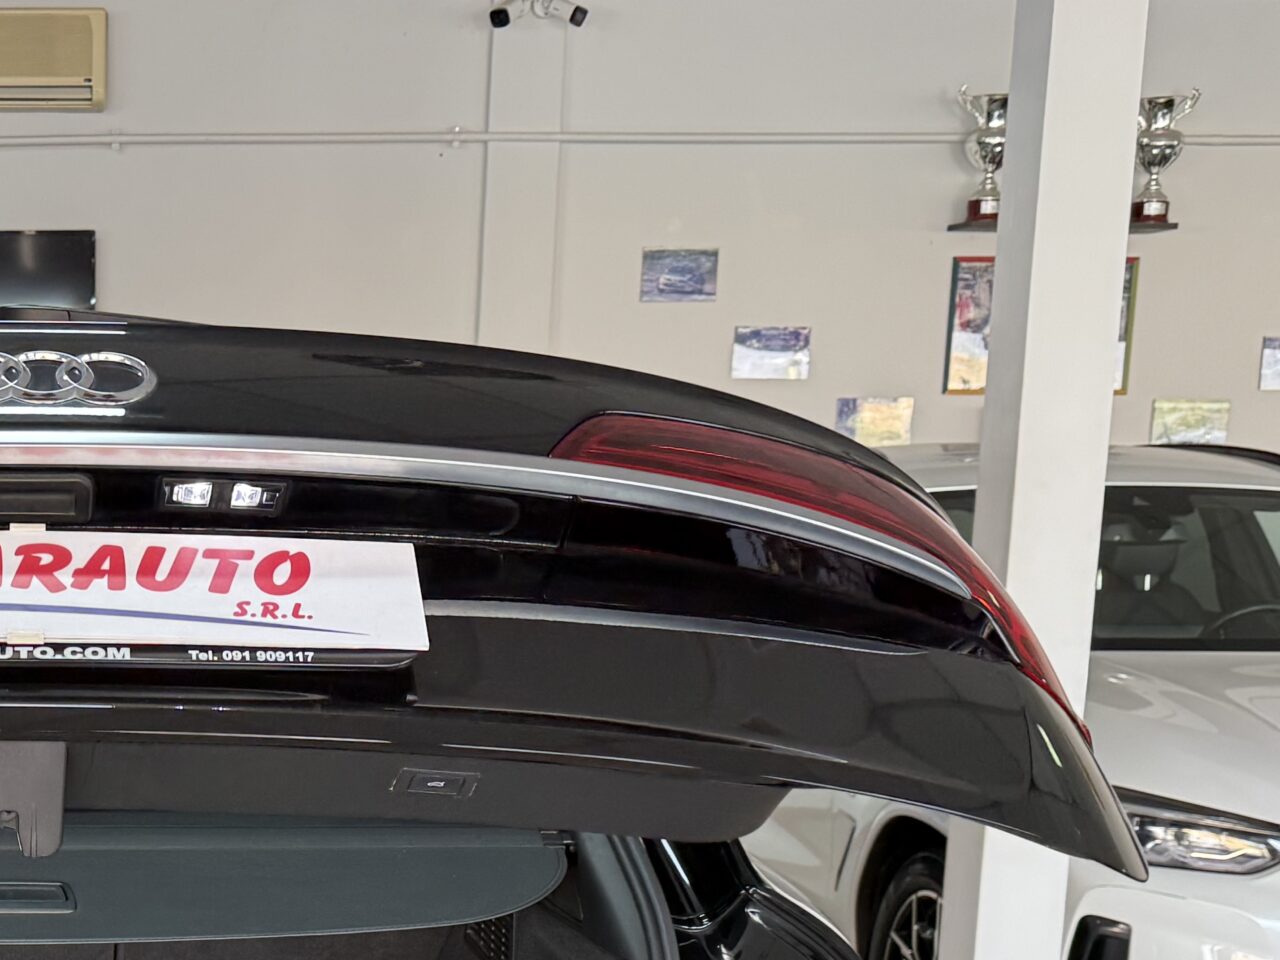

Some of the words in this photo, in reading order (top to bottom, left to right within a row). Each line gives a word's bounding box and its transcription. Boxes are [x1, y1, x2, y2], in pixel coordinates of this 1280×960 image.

[233, 601, 313, 620] S.R.L.
[188, 650, 218, 662] Tel.
[222, 650, 251, 662] 091
[256, 651, 314, 663] 909117
